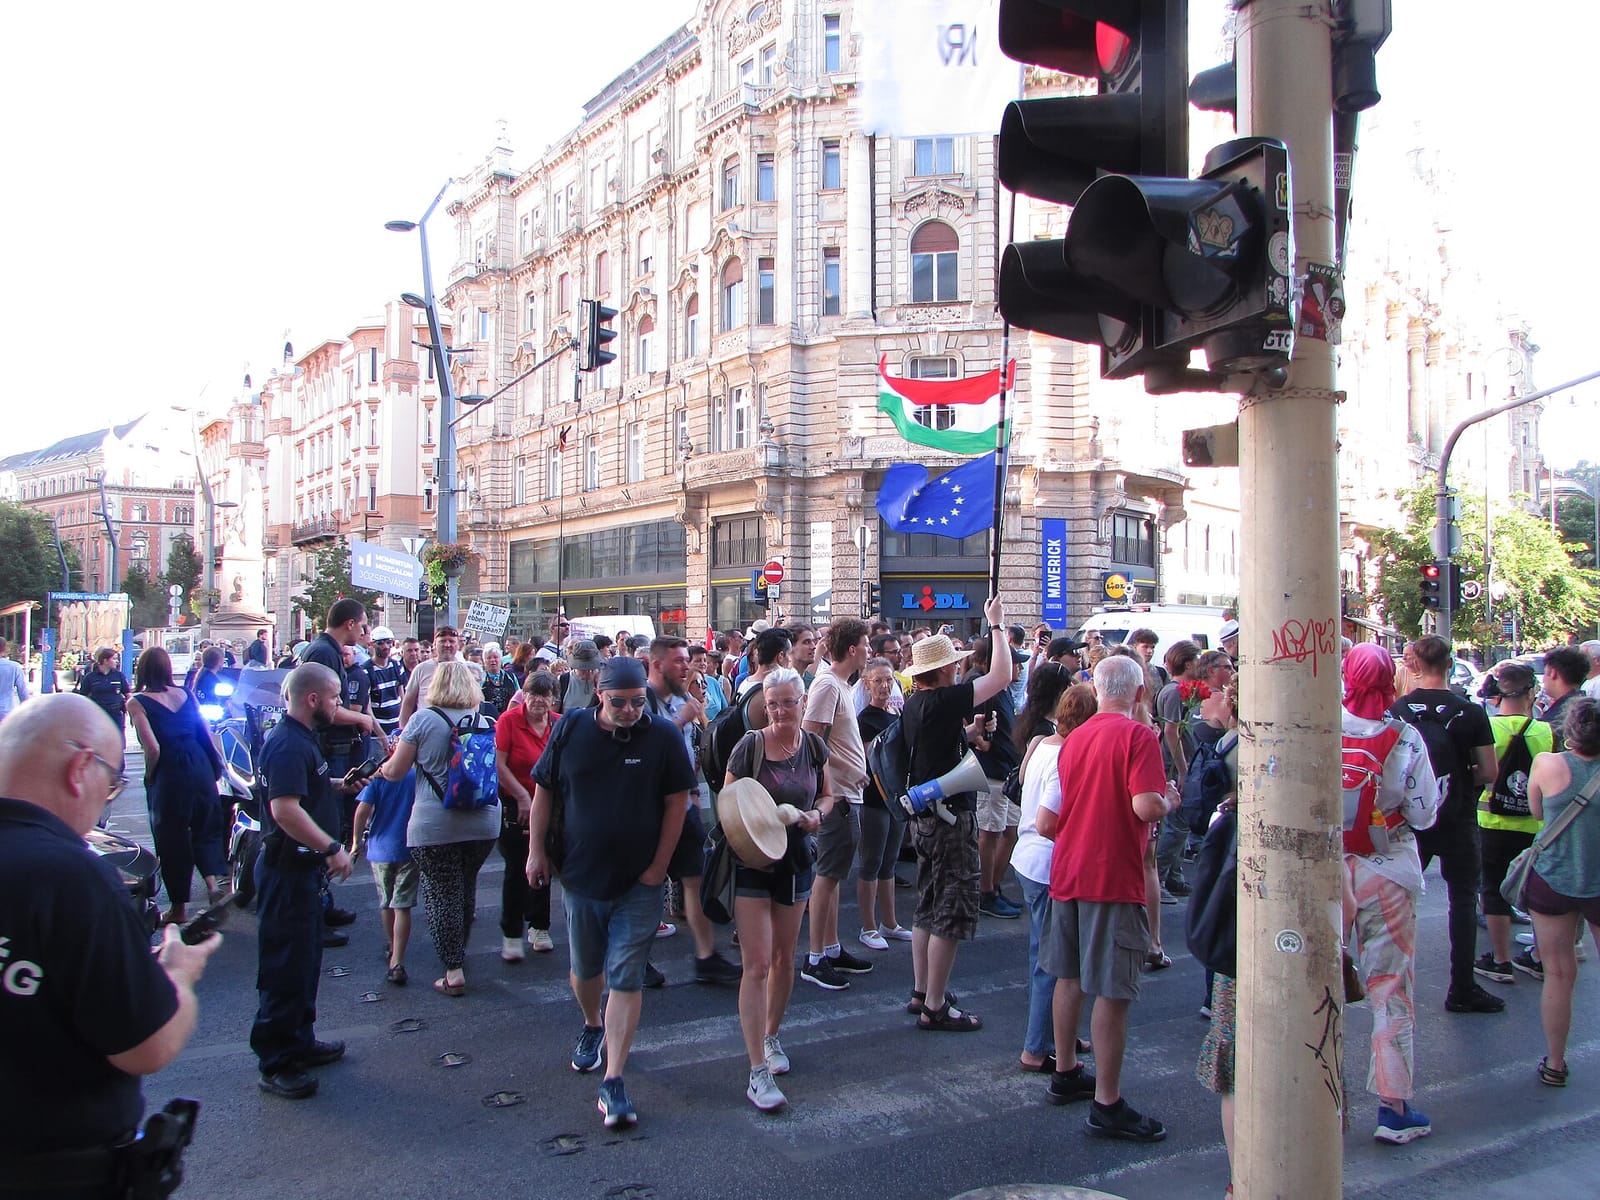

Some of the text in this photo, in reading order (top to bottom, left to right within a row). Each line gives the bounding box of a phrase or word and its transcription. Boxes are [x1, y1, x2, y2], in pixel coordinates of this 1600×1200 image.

[1047, 539, 1061, 598] MAVERICK
[472, 609, 485, 617] van
[468, 615, 486, 624] ebben
